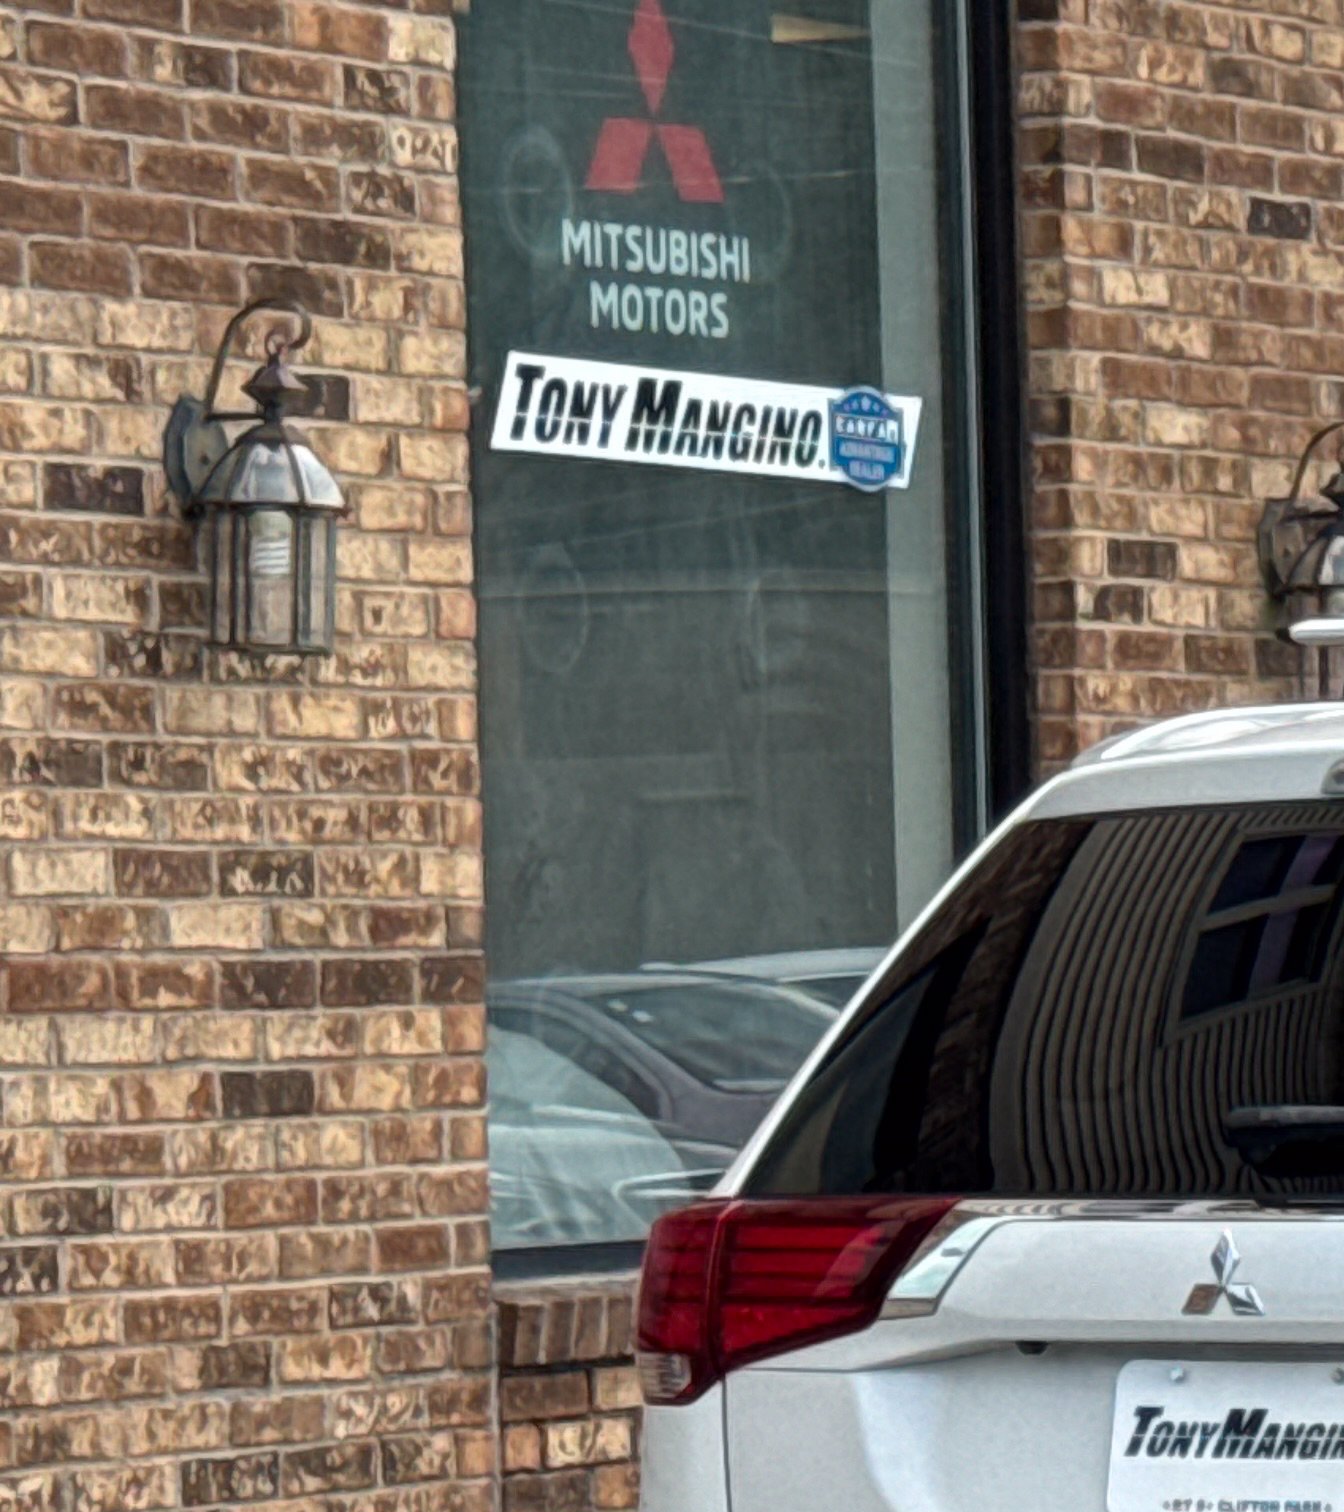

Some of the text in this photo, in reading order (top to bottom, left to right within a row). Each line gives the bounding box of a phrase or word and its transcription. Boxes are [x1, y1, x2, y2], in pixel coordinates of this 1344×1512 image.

[561, 218, 750, 284] MITSUBISHI
[589, 280, 730, 339] MOTORS
[509, 363, 628, 450] TONY
